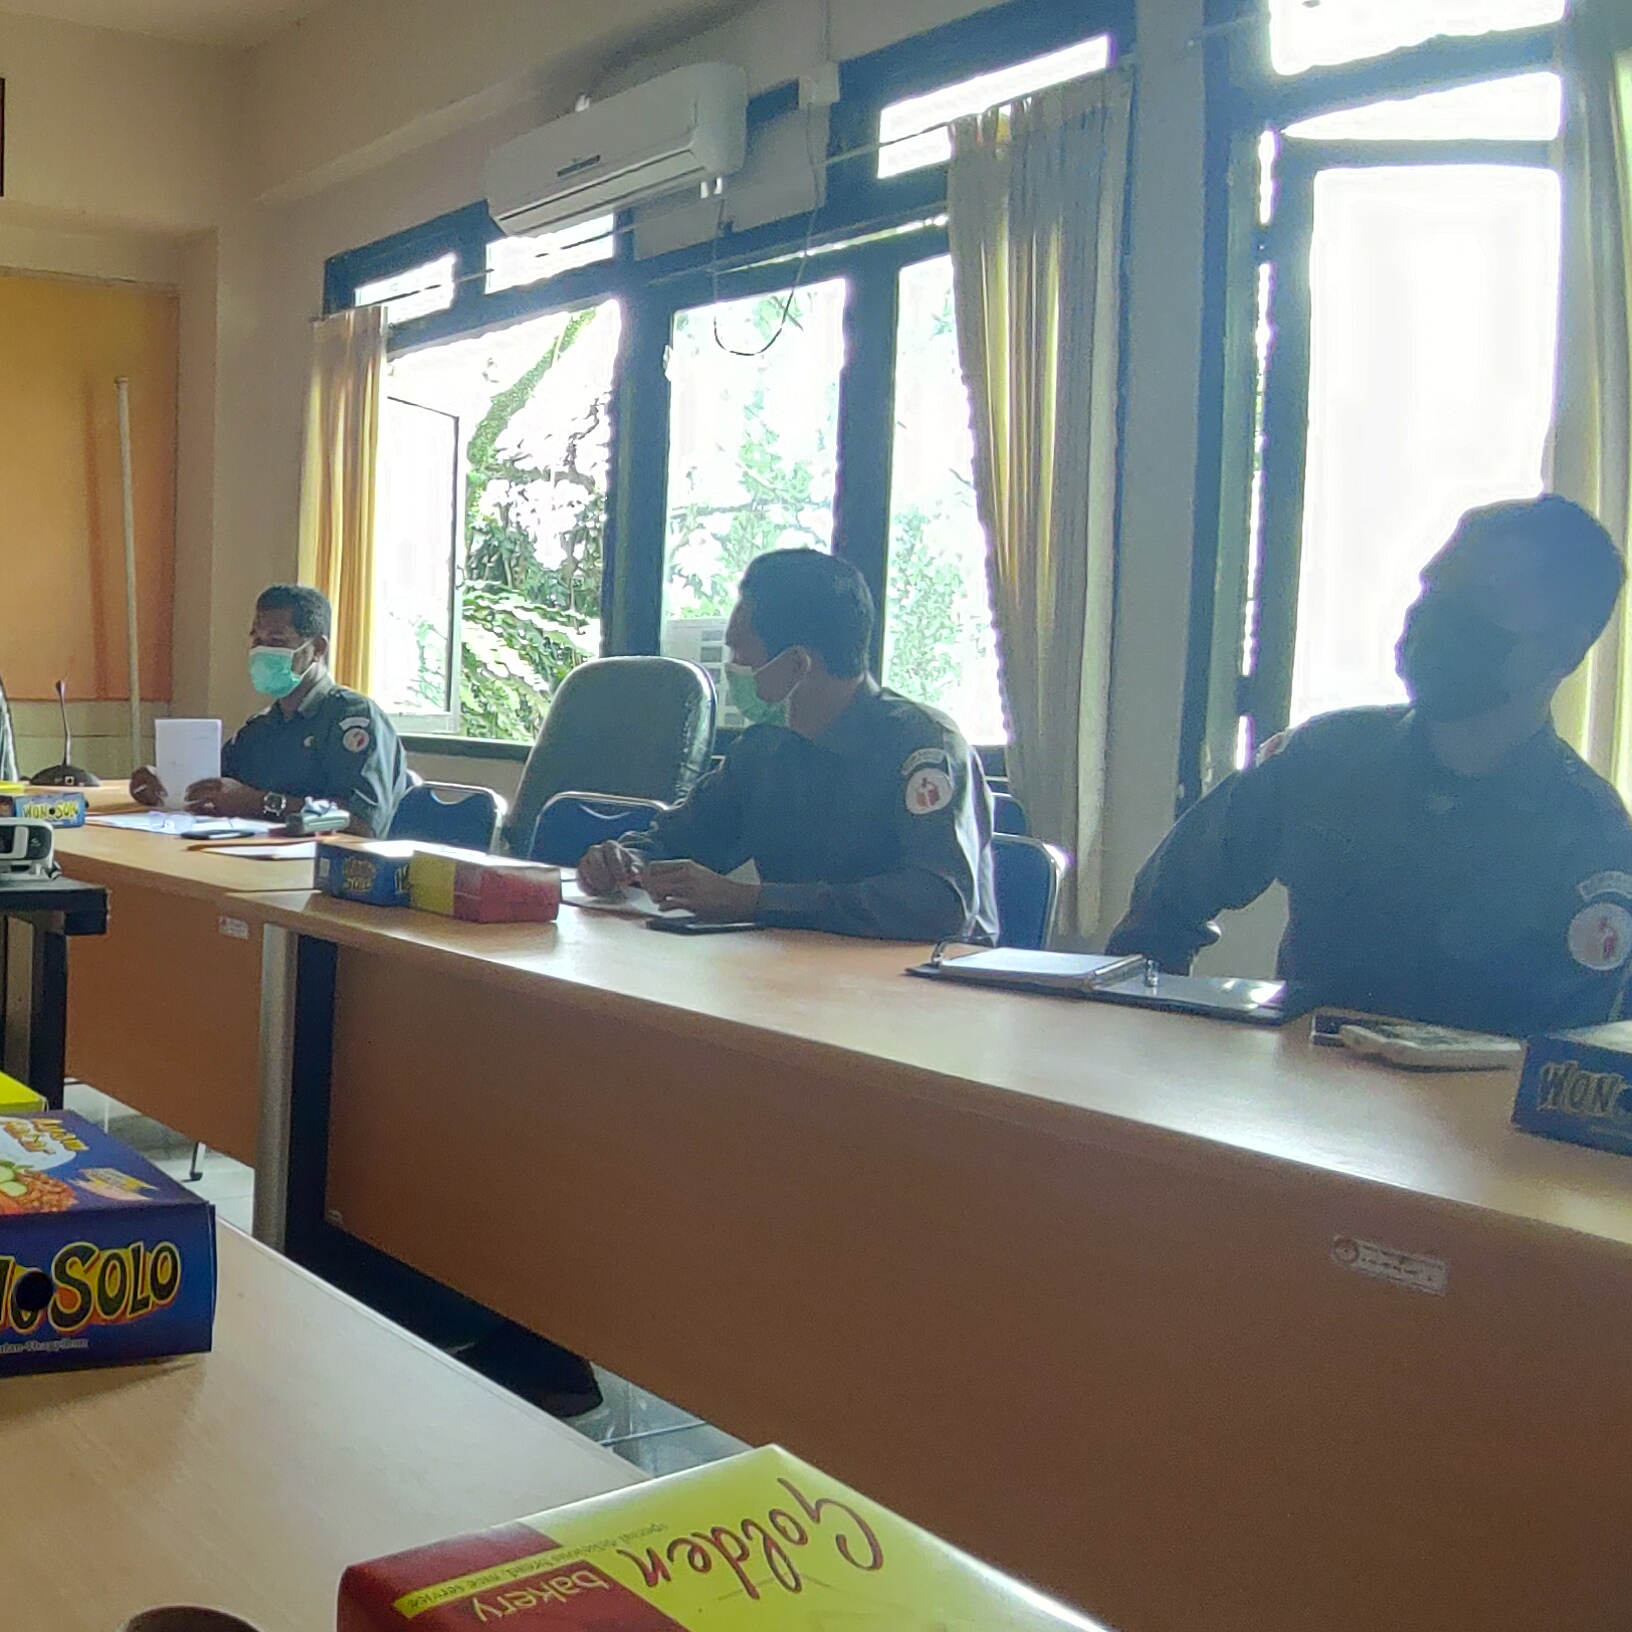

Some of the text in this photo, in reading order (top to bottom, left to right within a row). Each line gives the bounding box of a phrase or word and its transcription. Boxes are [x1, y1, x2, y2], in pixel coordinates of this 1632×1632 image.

[1536, 1060, 1630, 1119] WON
[49, 1241, 182, 1334] SOLO
[618, 1476, 884, 1600] Golden
[471, 1569, 610, 1622] bakery
